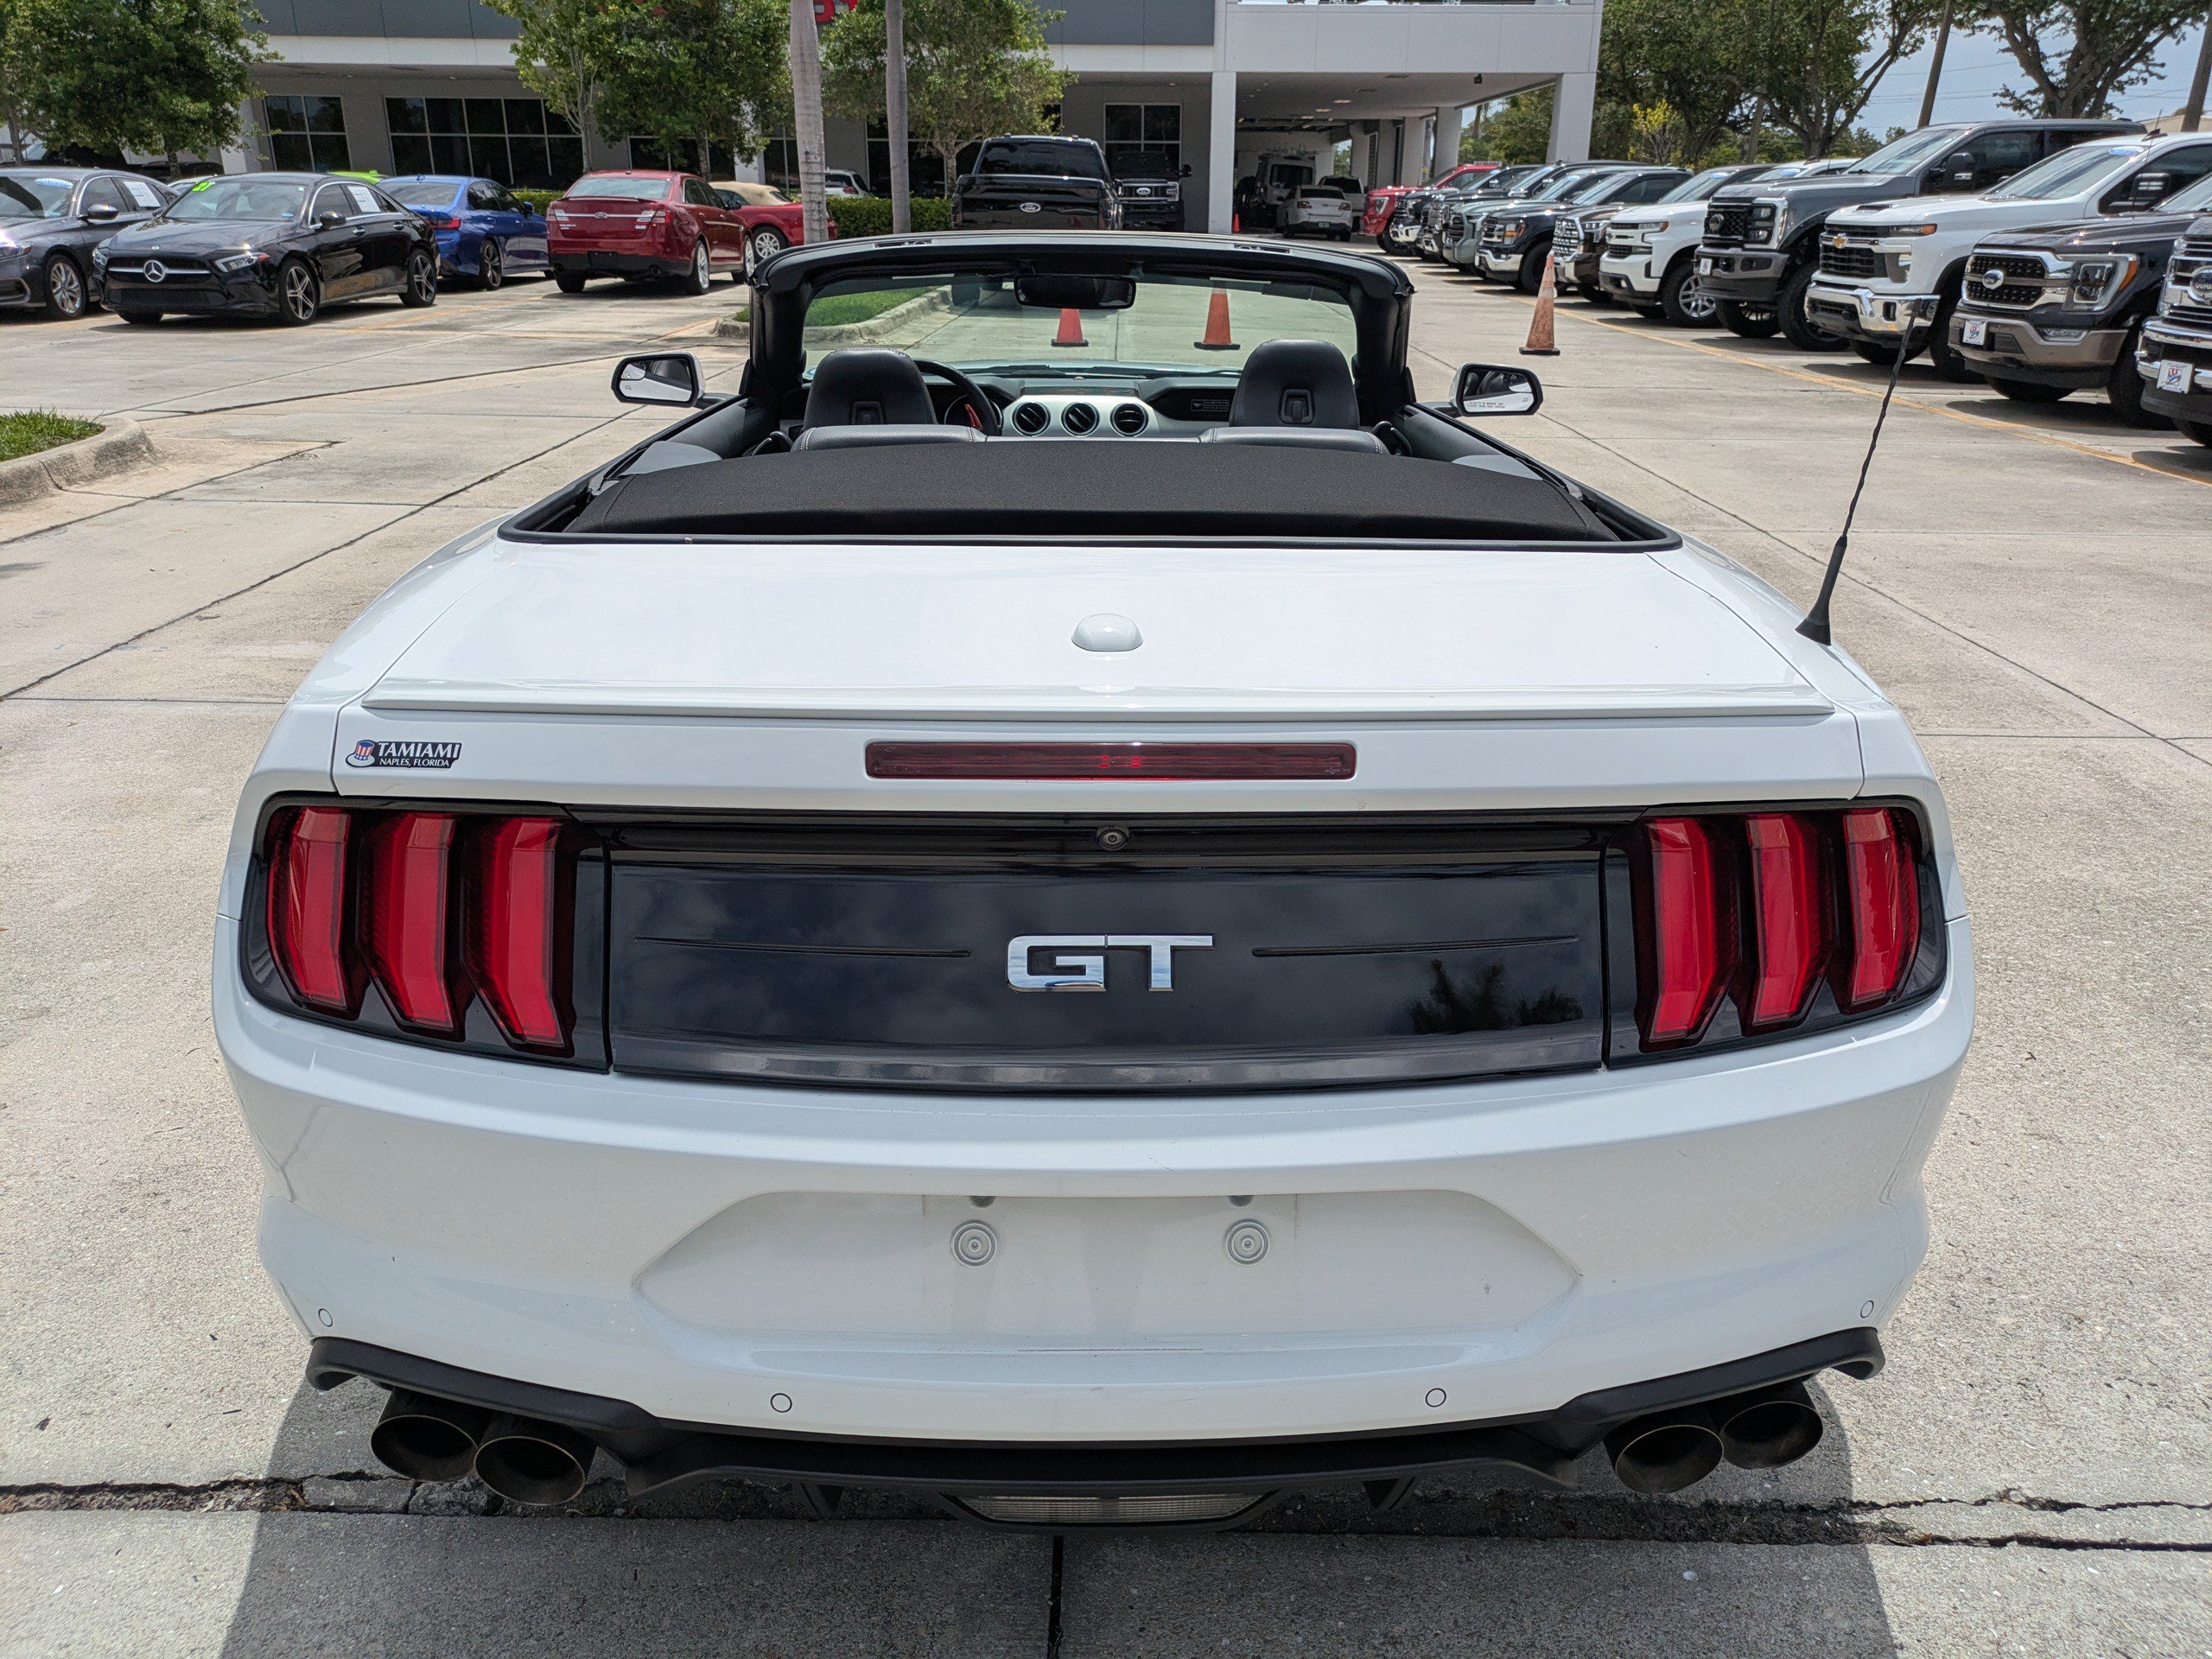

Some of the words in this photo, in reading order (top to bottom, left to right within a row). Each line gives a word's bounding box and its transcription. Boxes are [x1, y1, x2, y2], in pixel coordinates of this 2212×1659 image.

[378, 742, 461, 758] TAMIAMI
[379, 758, 411, 766] NAPLES,
[1007, 935, 1214, 992] GT
